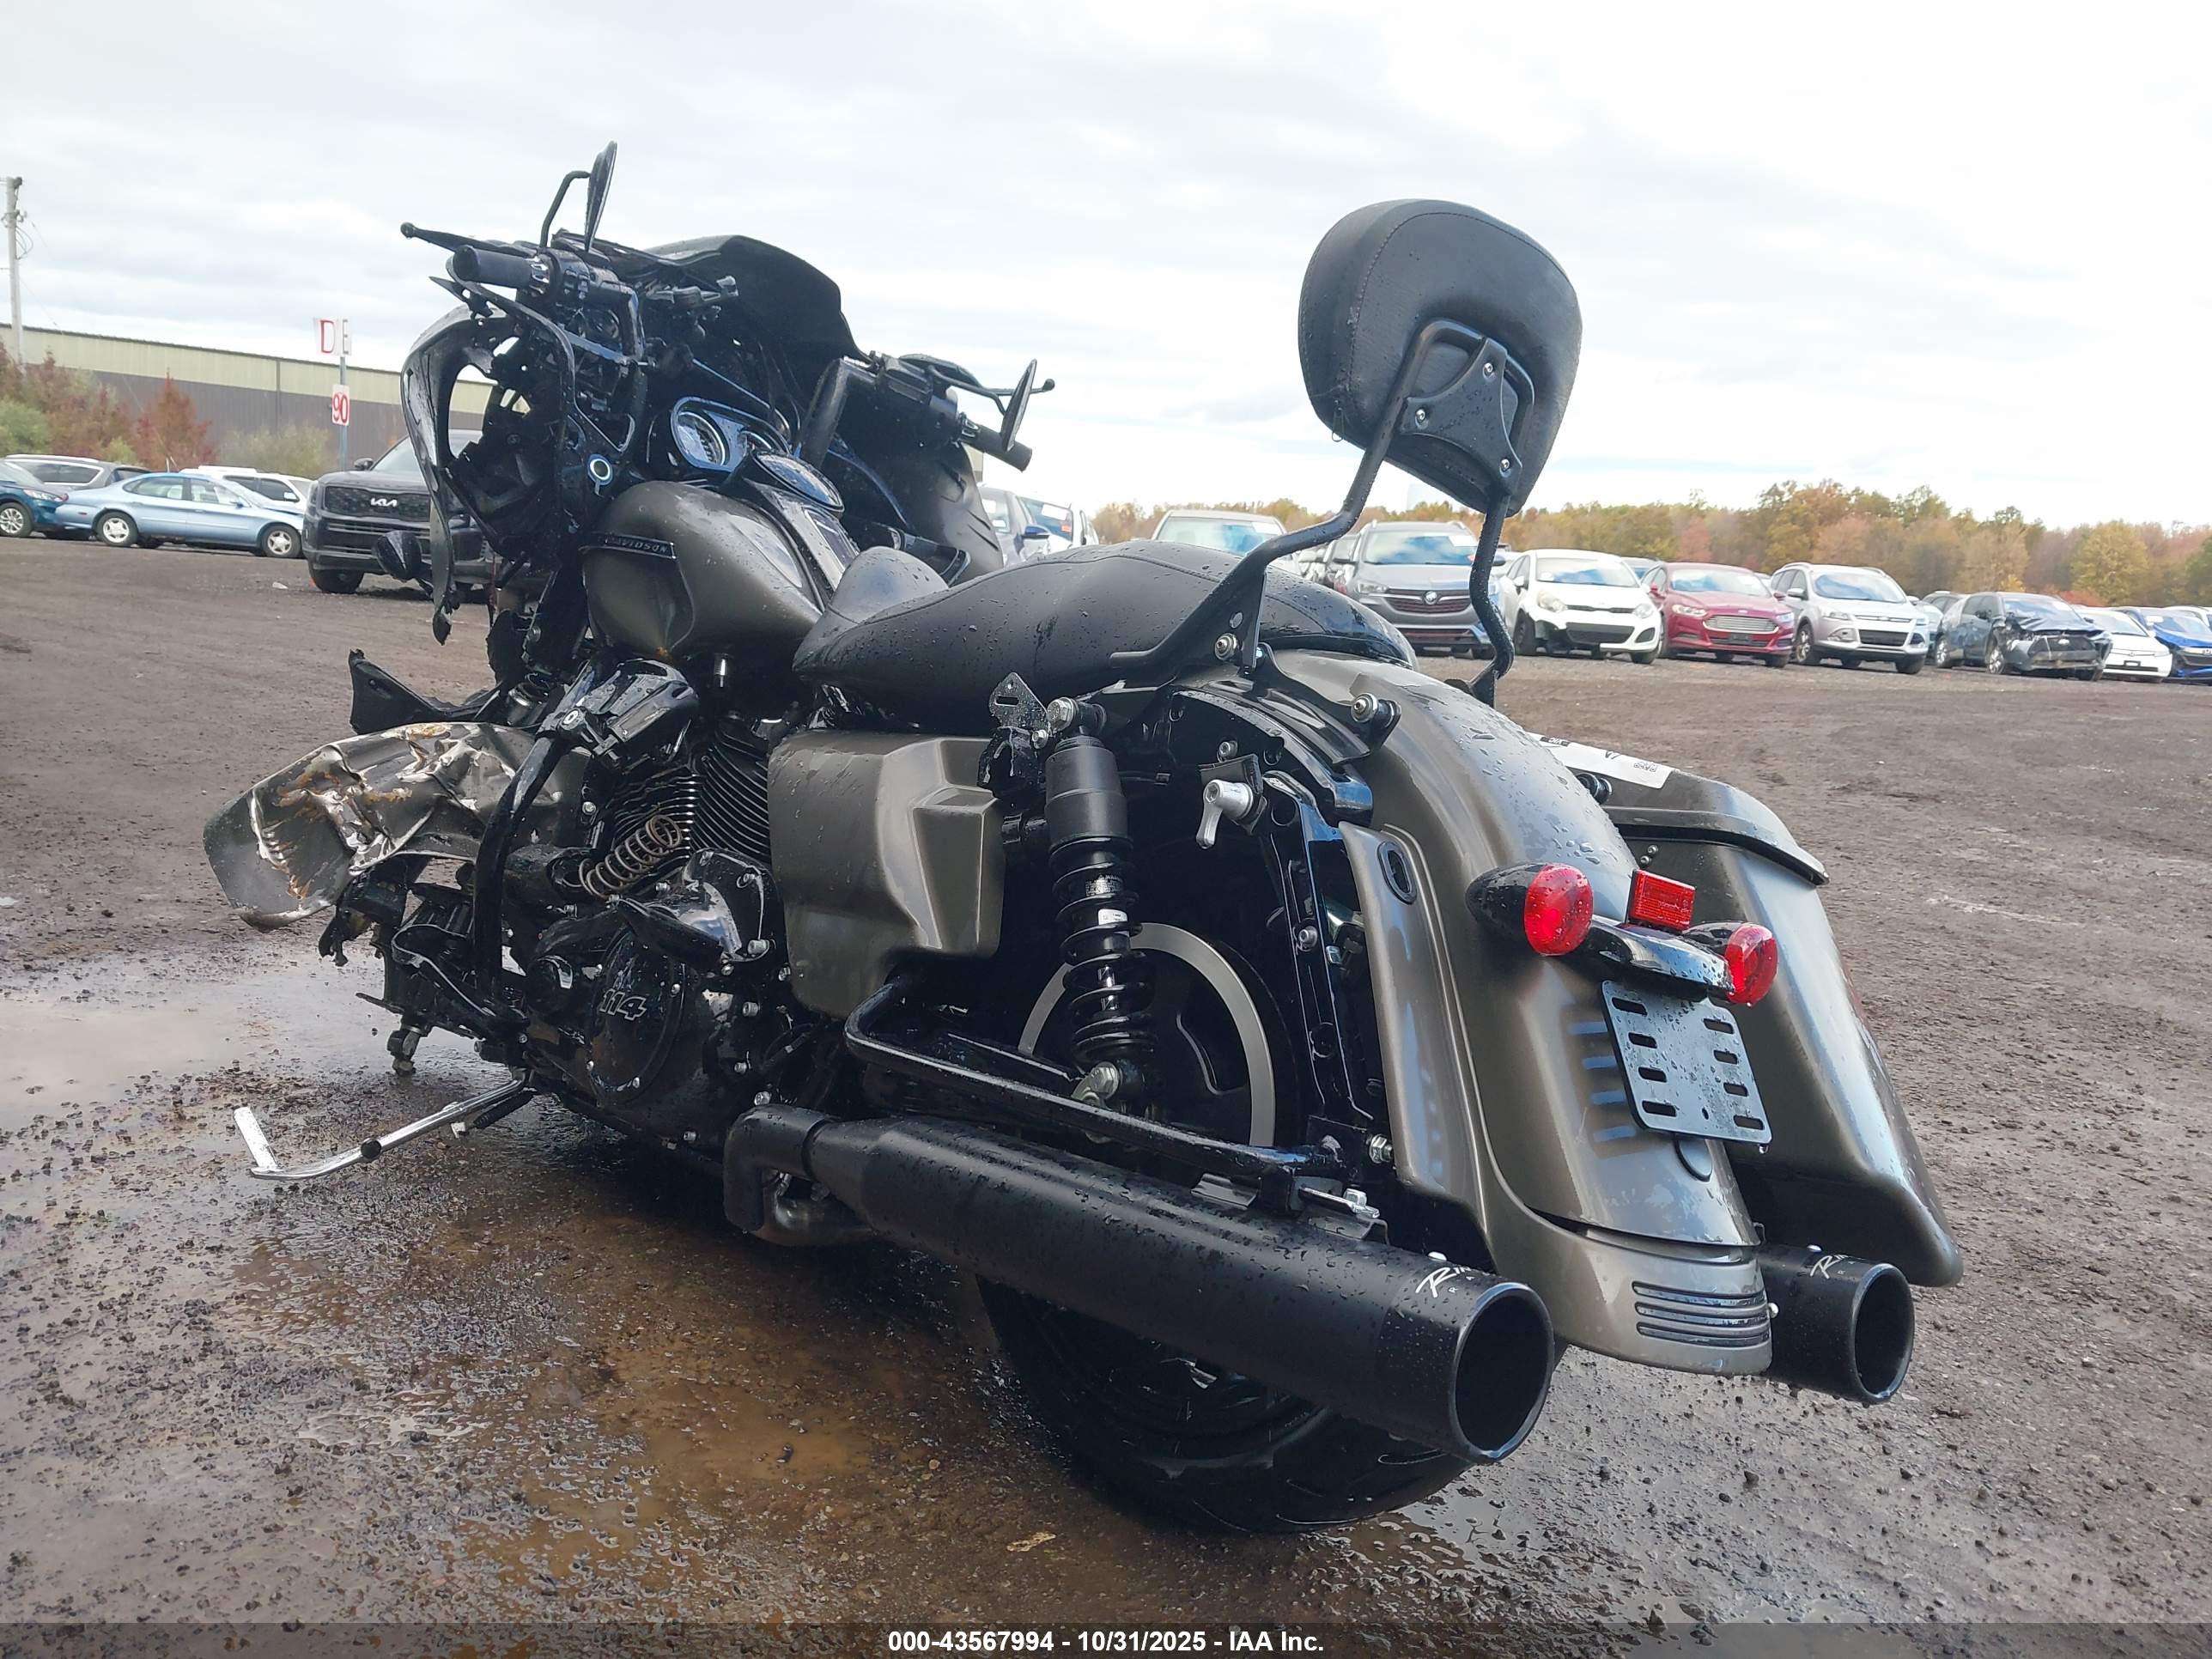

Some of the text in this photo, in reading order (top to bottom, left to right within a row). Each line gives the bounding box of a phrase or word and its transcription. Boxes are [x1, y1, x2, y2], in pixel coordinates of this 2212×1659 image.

[319, 319, 335, 354] D
[332, 392, 349, 423] 90
[599, 988, 647, 1021] 114
